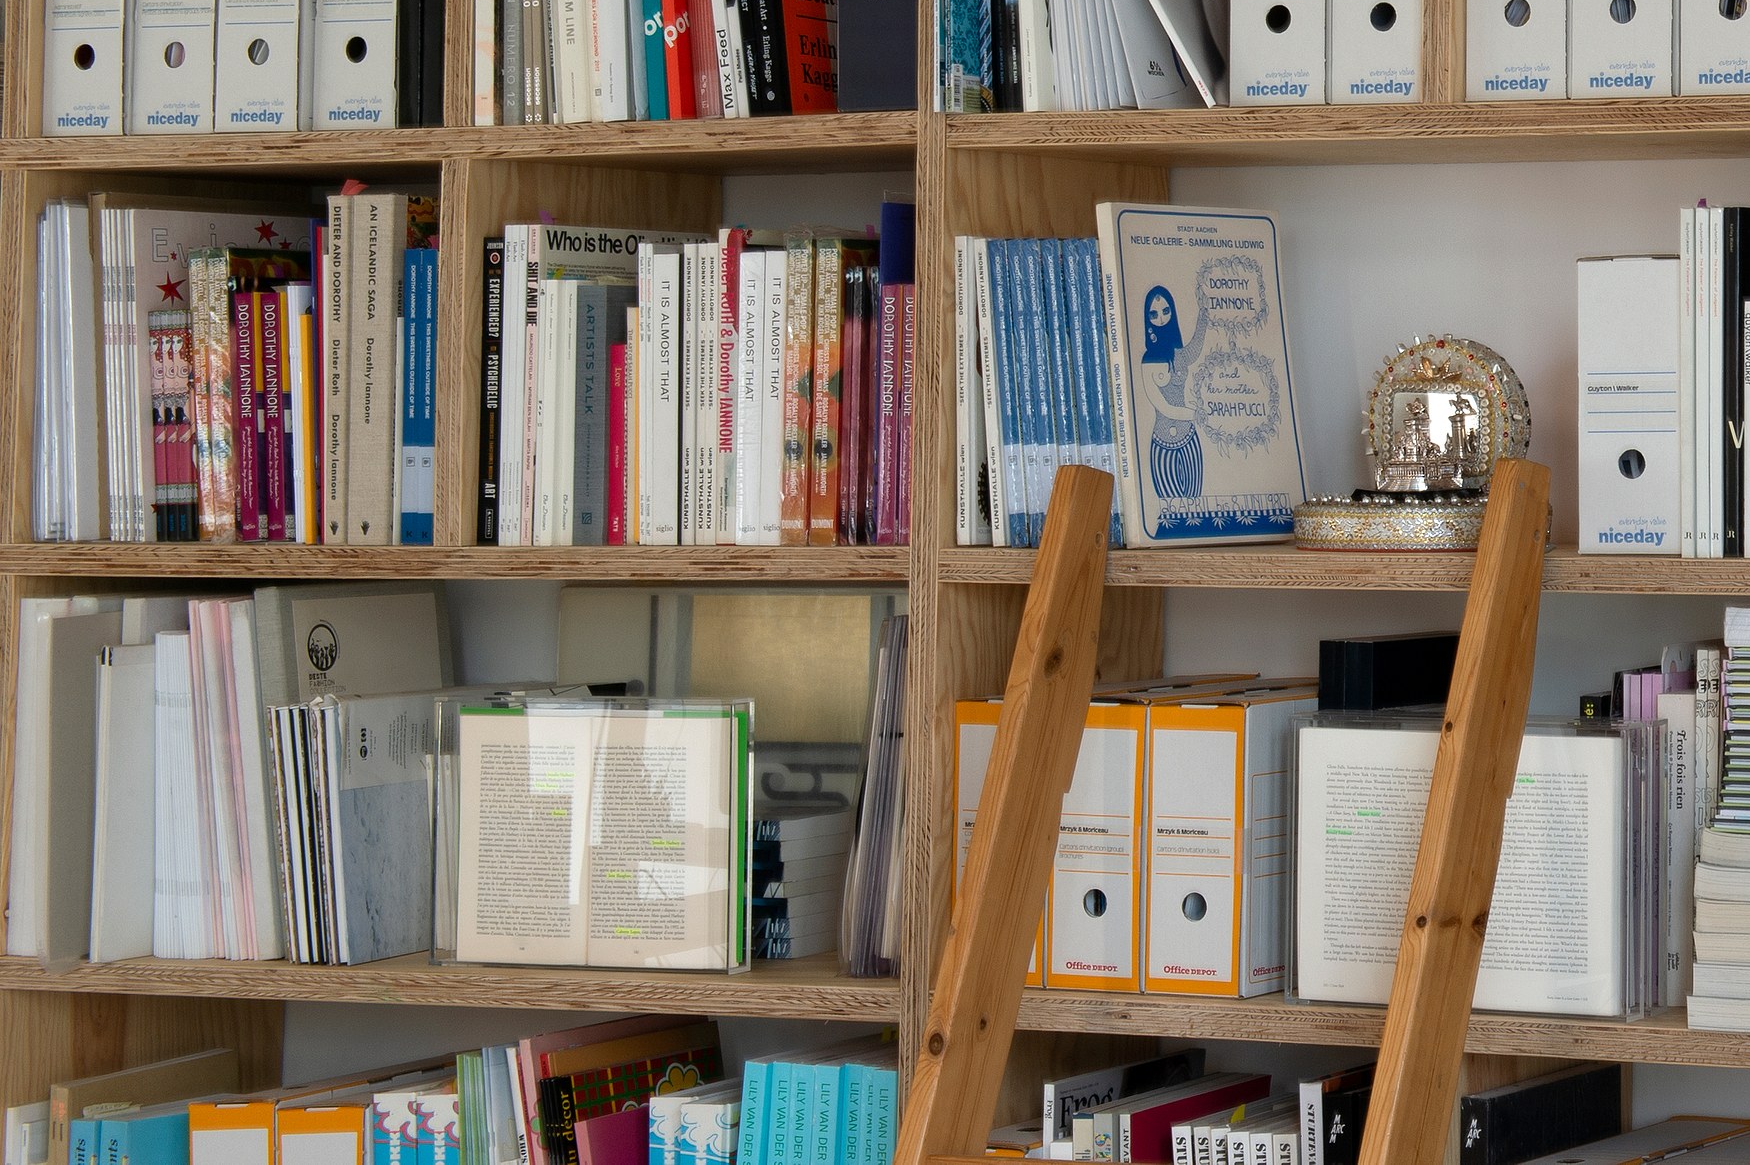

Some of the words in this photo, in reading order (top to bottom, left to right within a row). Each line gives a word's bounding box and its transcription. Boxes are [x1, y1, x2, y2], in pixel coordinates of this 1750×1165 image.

[565, 15, 575, 46] LINE
[507, 23, 516, 86] NUMERO
[718, 29, 730, 68] Feed
[799, 35, 837, 60] Erlin
[803, 64, 838, 93] Kagg
[1247, 80, 1307, 98] niceday
[1485, 74, 1547, 92] niceday
[507, 91, 516, 108] 12
[724, 74, 735, 109] Max
[57, 109, 109, 128] niceday
[333, 206, 341, 241] DIETER
[370, 204, 377, 218] AN
[547, 229, 579, 251] Who
[584, 230, 596, 252] is
[598, 233, 623, 254] the
[1130, 236, 1150, 245] NEUE
[1152, 237, 1183, 247] GALERIE
[1189, 238, 1231, 248] SAMMLUNG
[1233, 240, 1265, 249] LUDWIG
[333, 244, 341, 267] AND
[368, 223, 377, 286] ICELANDIC
[527, 261, 539, 286] SHIT
[662, 280, 670, 292] IT
[1209, 277, 1249, 291] DOROTHY
[332, 271, 341, 323] DOROTHY
[367, 289, 376, 321] SAGA
[488, 278, 500, 337] EXPERIENCED?
[526, 287, 538, 309] AND
[662, 296, 670, 308] IS
[1208, 296, 1255, 312] IANNONE
[526, 311, 537, 327] DIE
[238, 304, 250, 360] DOROTHY
[585, 304, 595, 377] ARTISTS
[661, 314, 670, 365] ALMOST
[332, 339, 341, 369] Dieter
[720, 341, 735, 395] Dorothy
[240, 364, 252, 418] IANNONE
[332, 373, 340, 396] Roth
[486, 354, 499, 409] PSYCHEDELIC
[661, 370, 669, 402] THAT
[584, 383, 593, 414] TALK
[331, 414, 340, 452] Dorothy
[719, 397, 733, 453] IANNONE
[330, 456, 339, 500] Iannone
[484, 482, 495, 499] ART
[1599, 527, 1663, 546] niceday
[1677, 730, 1687, 757] Trois
[1677, 759, 1685, 780] fois
[1164, 965, 1189, 975] Office
[1191, 968, 1216, 976] DEPOT
[820, 1083, 830, 1106] LILY
[819, 1110, 829, 1132] VAN
[818, 1137, 828, 1160] DER
